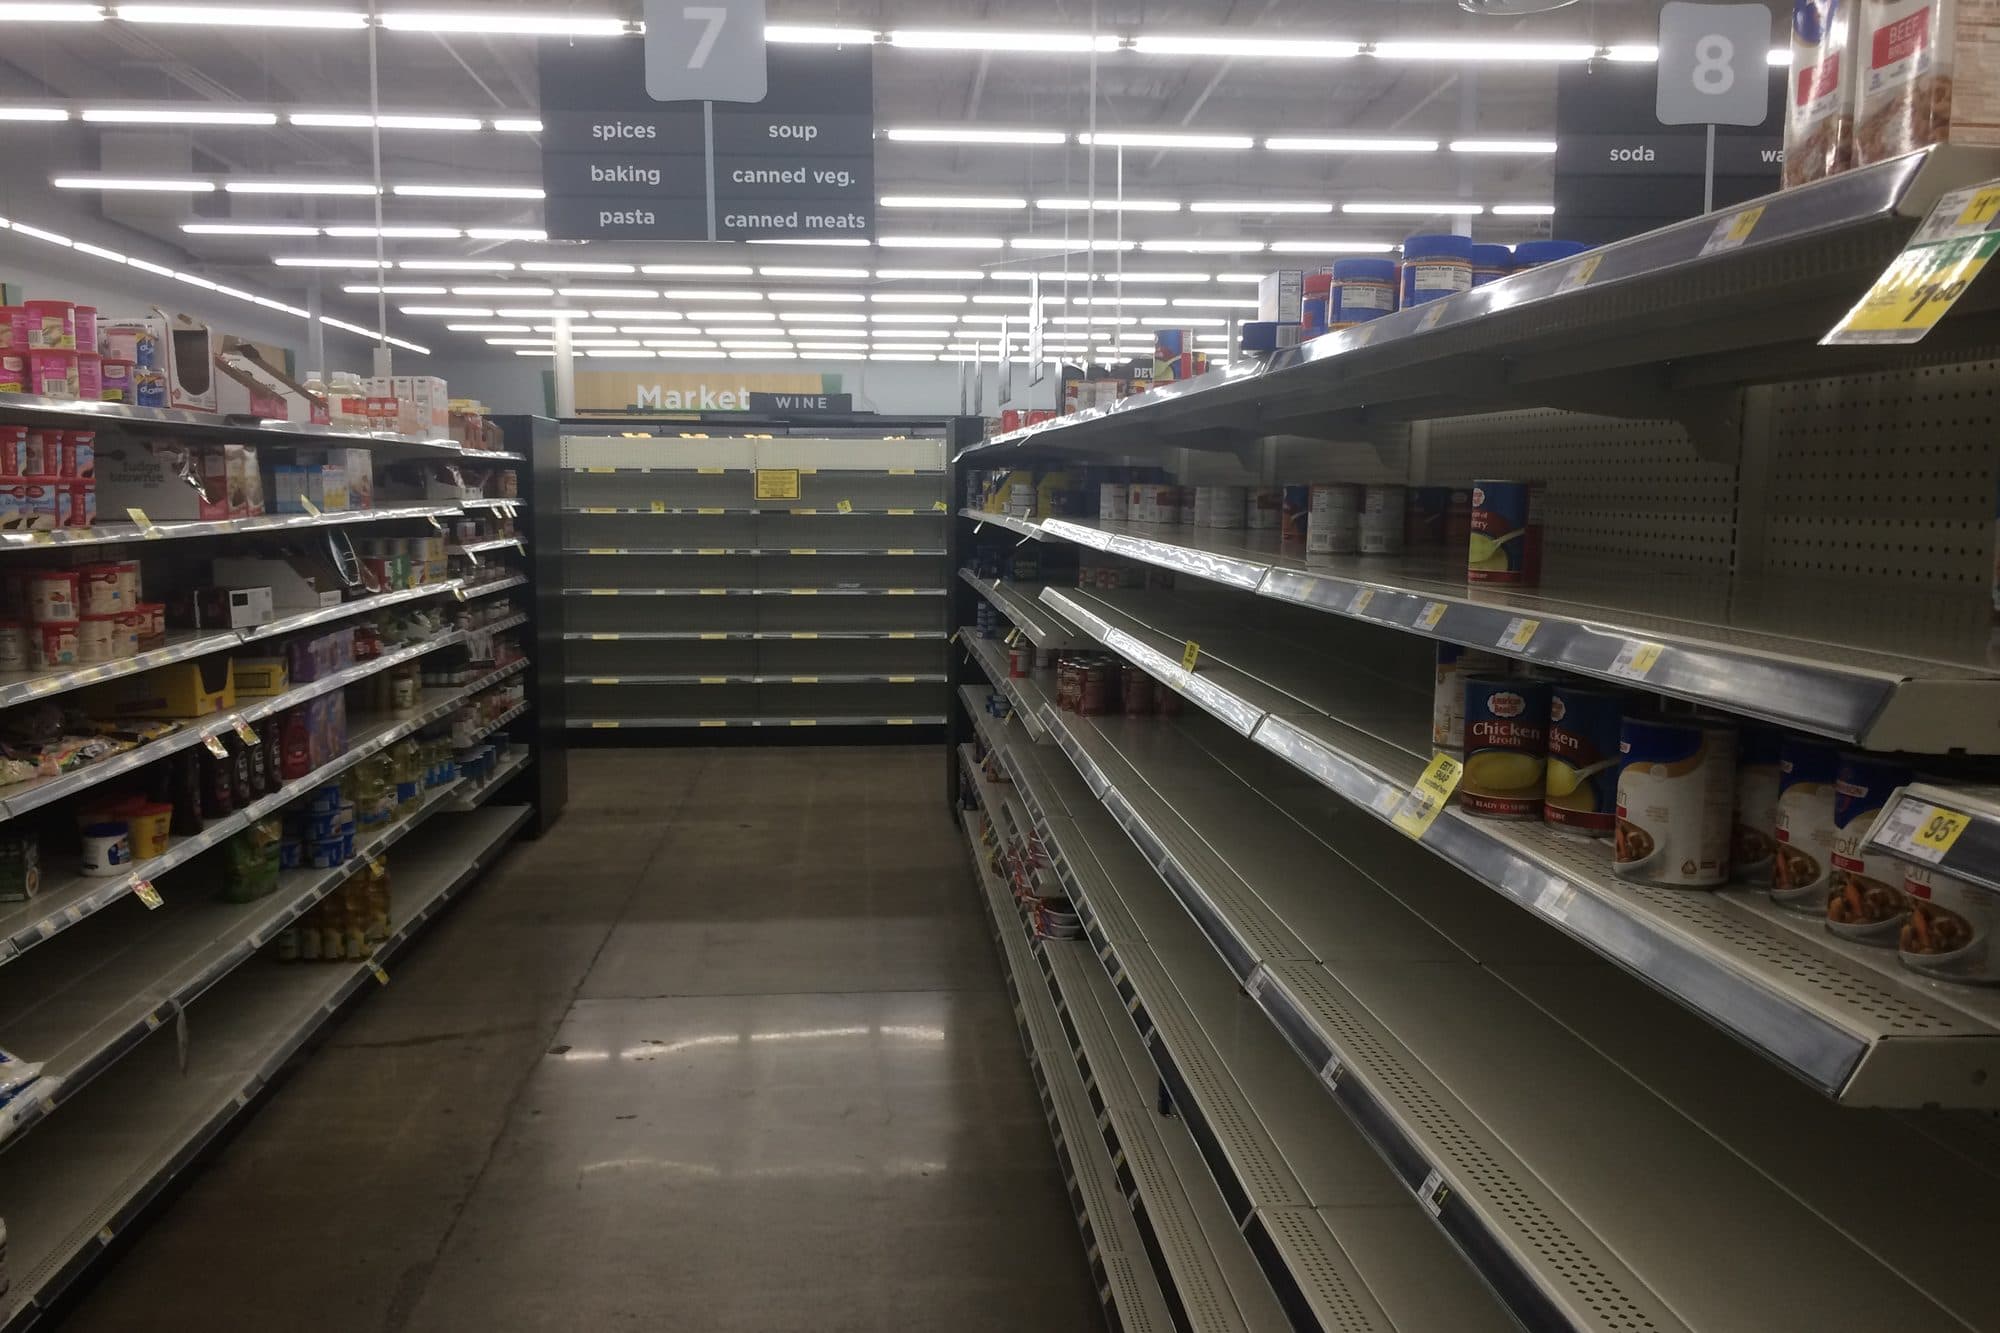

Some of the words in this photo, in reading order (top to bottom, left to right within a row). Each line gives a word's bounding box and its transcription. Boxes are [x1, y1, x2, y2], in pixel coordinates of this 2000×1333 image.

[683, 7, 728, 69] 7
[1692, 33, 1735, 95] 8
[592, 121, 656, 143] spices
[768, 123, 818, 142] soup
[1609, 144, 1656, 163] soda
[1760, 150, 1785, 163] wa
[591, 165, 661, 186] baking
[732, 168, 806, 185] canned
[813, 170, 856, 187] veg.
[599, 210, 655, 228] pasta
[724, 212, 798, 229] canned
[805, 213, 866, 230] meats
[1134, 367, 1153, 379] DEV
[636, 384, 750, 410] Market
[775, 397, 828, 410] WINE
[1472, 722, 1540, 740] Chicken
[1488, 734, 1521, 745] Broth
